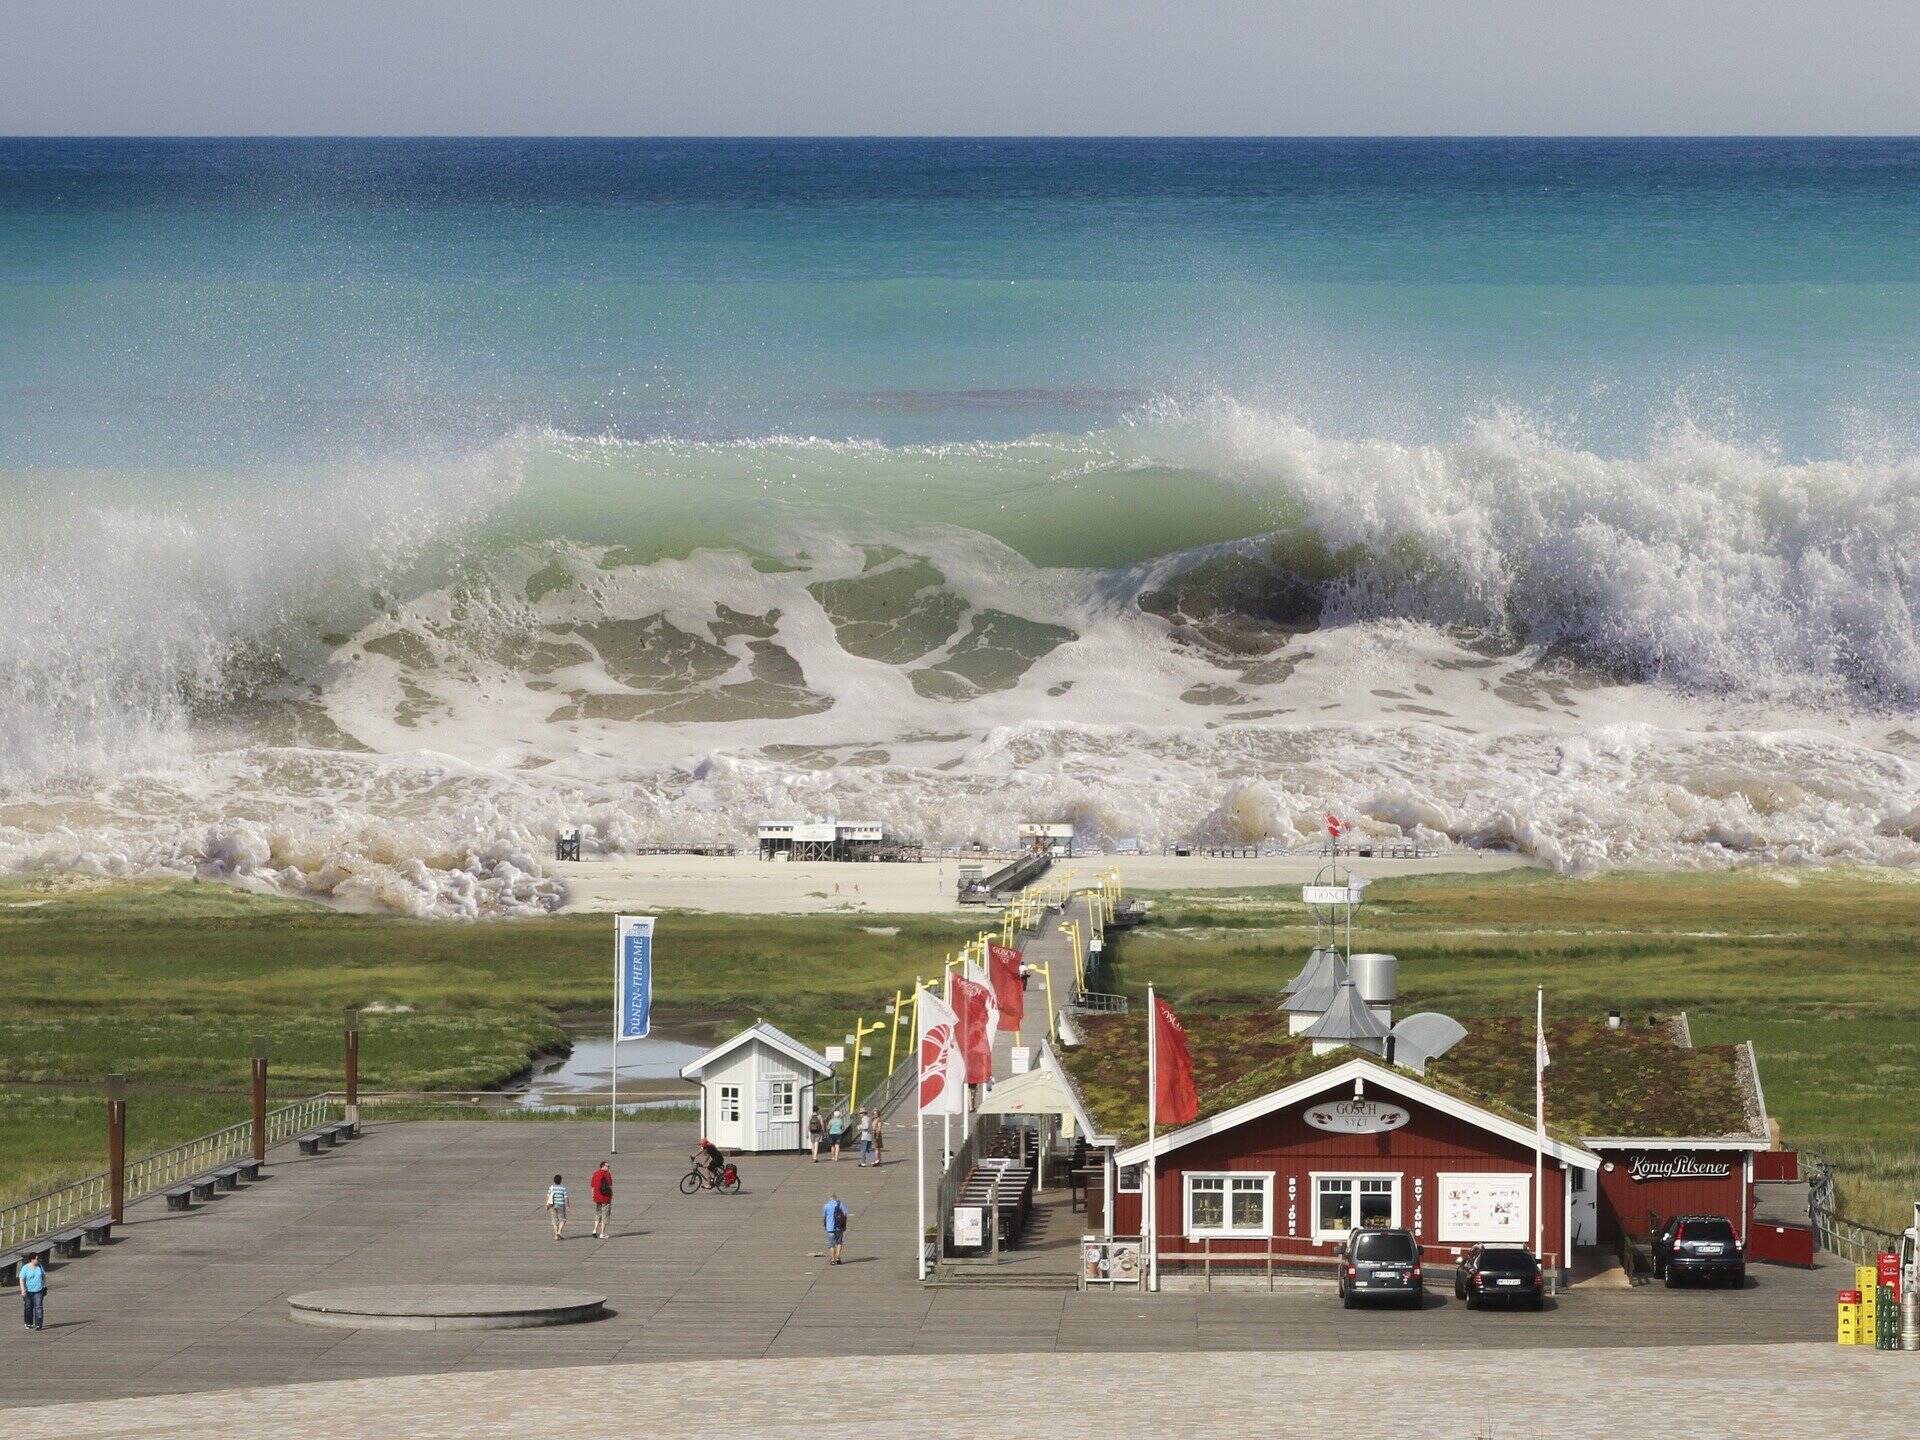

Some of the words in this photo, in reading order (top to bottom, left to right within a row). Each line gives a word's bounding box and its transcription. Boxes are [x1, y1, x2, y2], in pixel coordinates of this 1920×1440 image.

[630, 937, 643, 1035] DÜNEN-THERME
[1337, 1103, 1376, 1115] GOSCH
[1288, 1177, 1297, 1202] BOY
[1414, 1178, 1422, 1202] BOY
